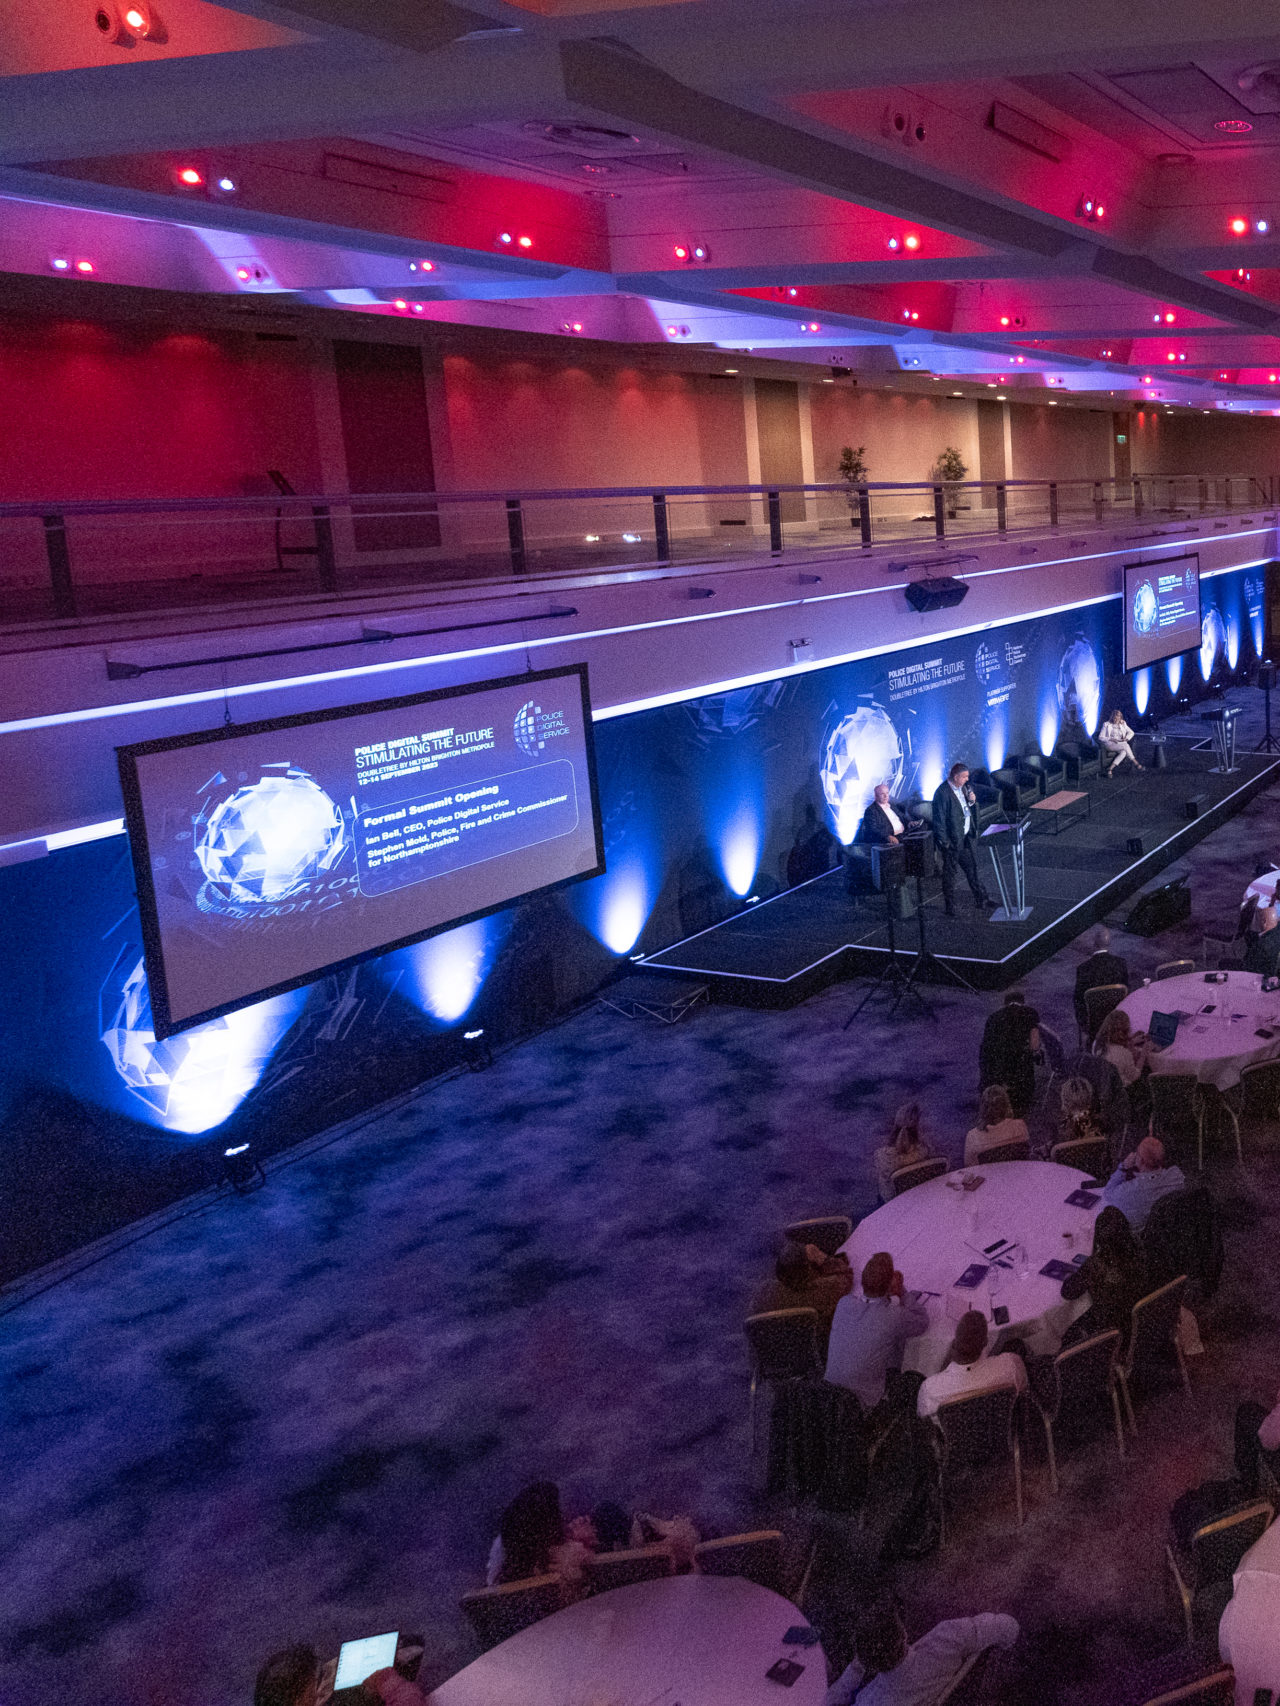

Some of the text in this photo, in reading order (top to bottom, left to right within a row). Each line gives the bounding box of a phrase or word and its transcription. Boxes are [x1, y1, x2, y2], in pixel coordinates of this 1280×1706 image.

[888, 658, 943, 679] POLICE DIGITAL SUMMIT
[889, 660, 966, 691] STIMULATING THE FUTURE
[536, 710, 564, 722] POLICE
[537, 719, 566, 731] DIGITAL
[355, 728, 454, 756] POLICE DIGITAL SUMMIT
[356, 728, 494, 768] STIMULATING THE FUTURE
[538, 726, 570, 740] SERVICE
[357, 741, 495, 779] DOUBLETREE BY HILTON BRIGHTON METROPOLE
[358, 761, 439, 786] 12-14 SEPTEMBER 2023
[363, 785, 499, 828] Formal Summit Opening
[365, 799, 510, 846] Ian Bell, CEO, Police Digital Service
[367, 794, 568, 859] Stephen Mold, Police, Fire and Crime Commissioner
[368, 835, 460, 868] for Northamptonshire
